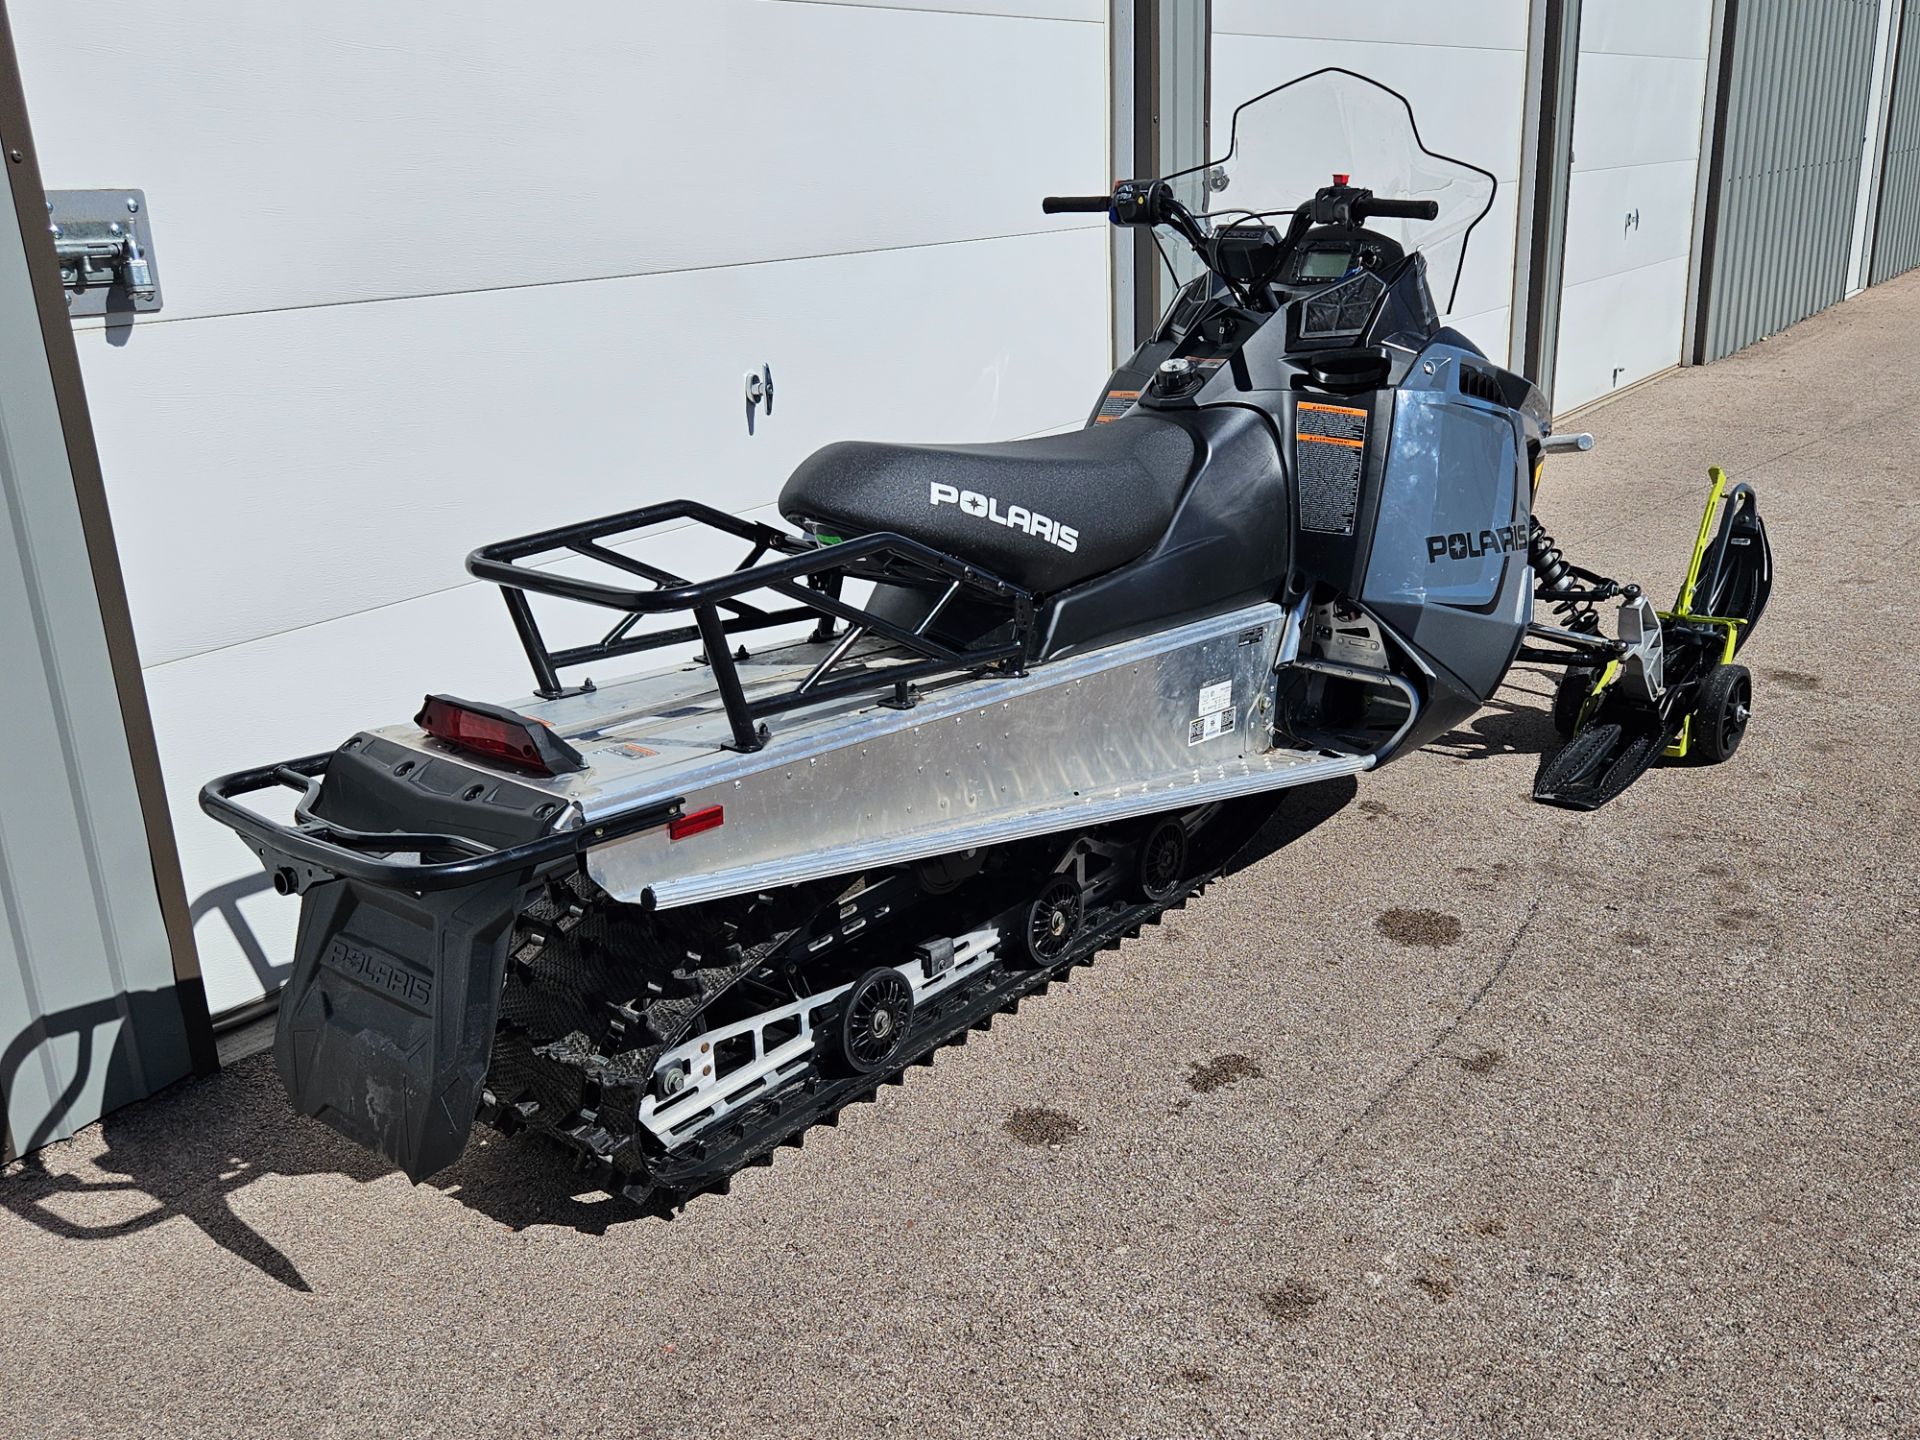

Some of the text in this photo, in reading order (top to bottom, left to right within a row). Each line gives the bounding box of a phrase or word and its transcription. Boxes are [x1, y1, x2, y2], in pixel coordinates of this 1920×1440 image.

[930, 481, 1079, 553] POLARIS
[1425, 524, 1528, 563] POLARIS
[329, 939, 433, 1006] POLARIS
